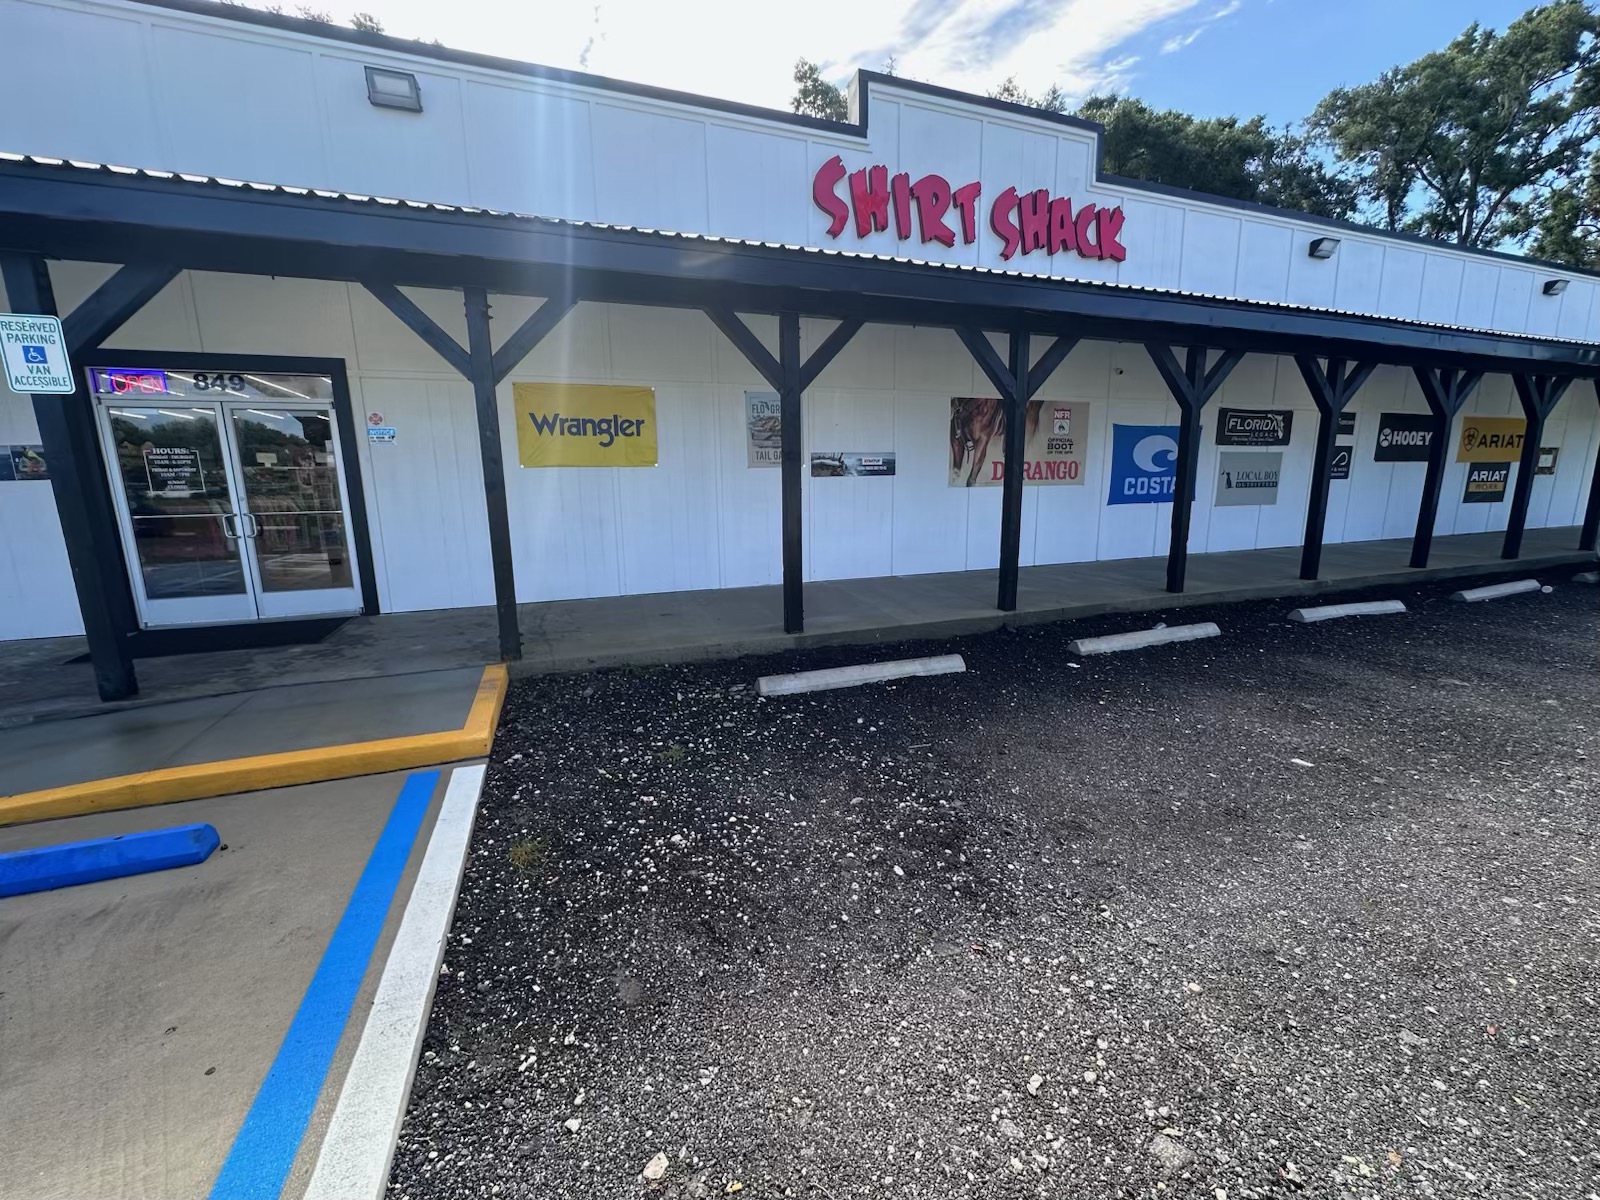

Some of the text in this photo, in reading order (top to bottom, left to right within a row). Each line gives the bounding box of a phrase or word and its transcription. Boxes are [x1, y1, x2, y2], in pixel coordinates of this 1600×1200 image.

[813, 155, 1126, 262] SHIRT SHACK
[0, 320, 57, 333] RESERVED
[6, 333, 56, 345] PARKING
[26, 365, 51, 375] VAN
[14, 376, 69, 387] ACCESSIBLE
[112, 374, 165, 393] OPEN
[193, 373, 245, 391] 849
[752, 404, 766, 414] FLO
[1054, 410, 1071, 419] NFR
[528, 412, 645, 447] Wrangler
[1228, 418, 1280, 431] FLORIDA
[1391, 431, 1433, 446] HOOEY
[1477, 434, 1524, 449] ARIAT
[755, 450, 772, 461] TAIL
[991, 461, 1079, 481] DRANGO
[1236, 471, 1279, 481] LOCAL BOY
[1470, 470, 1508, 482] ARIAT
